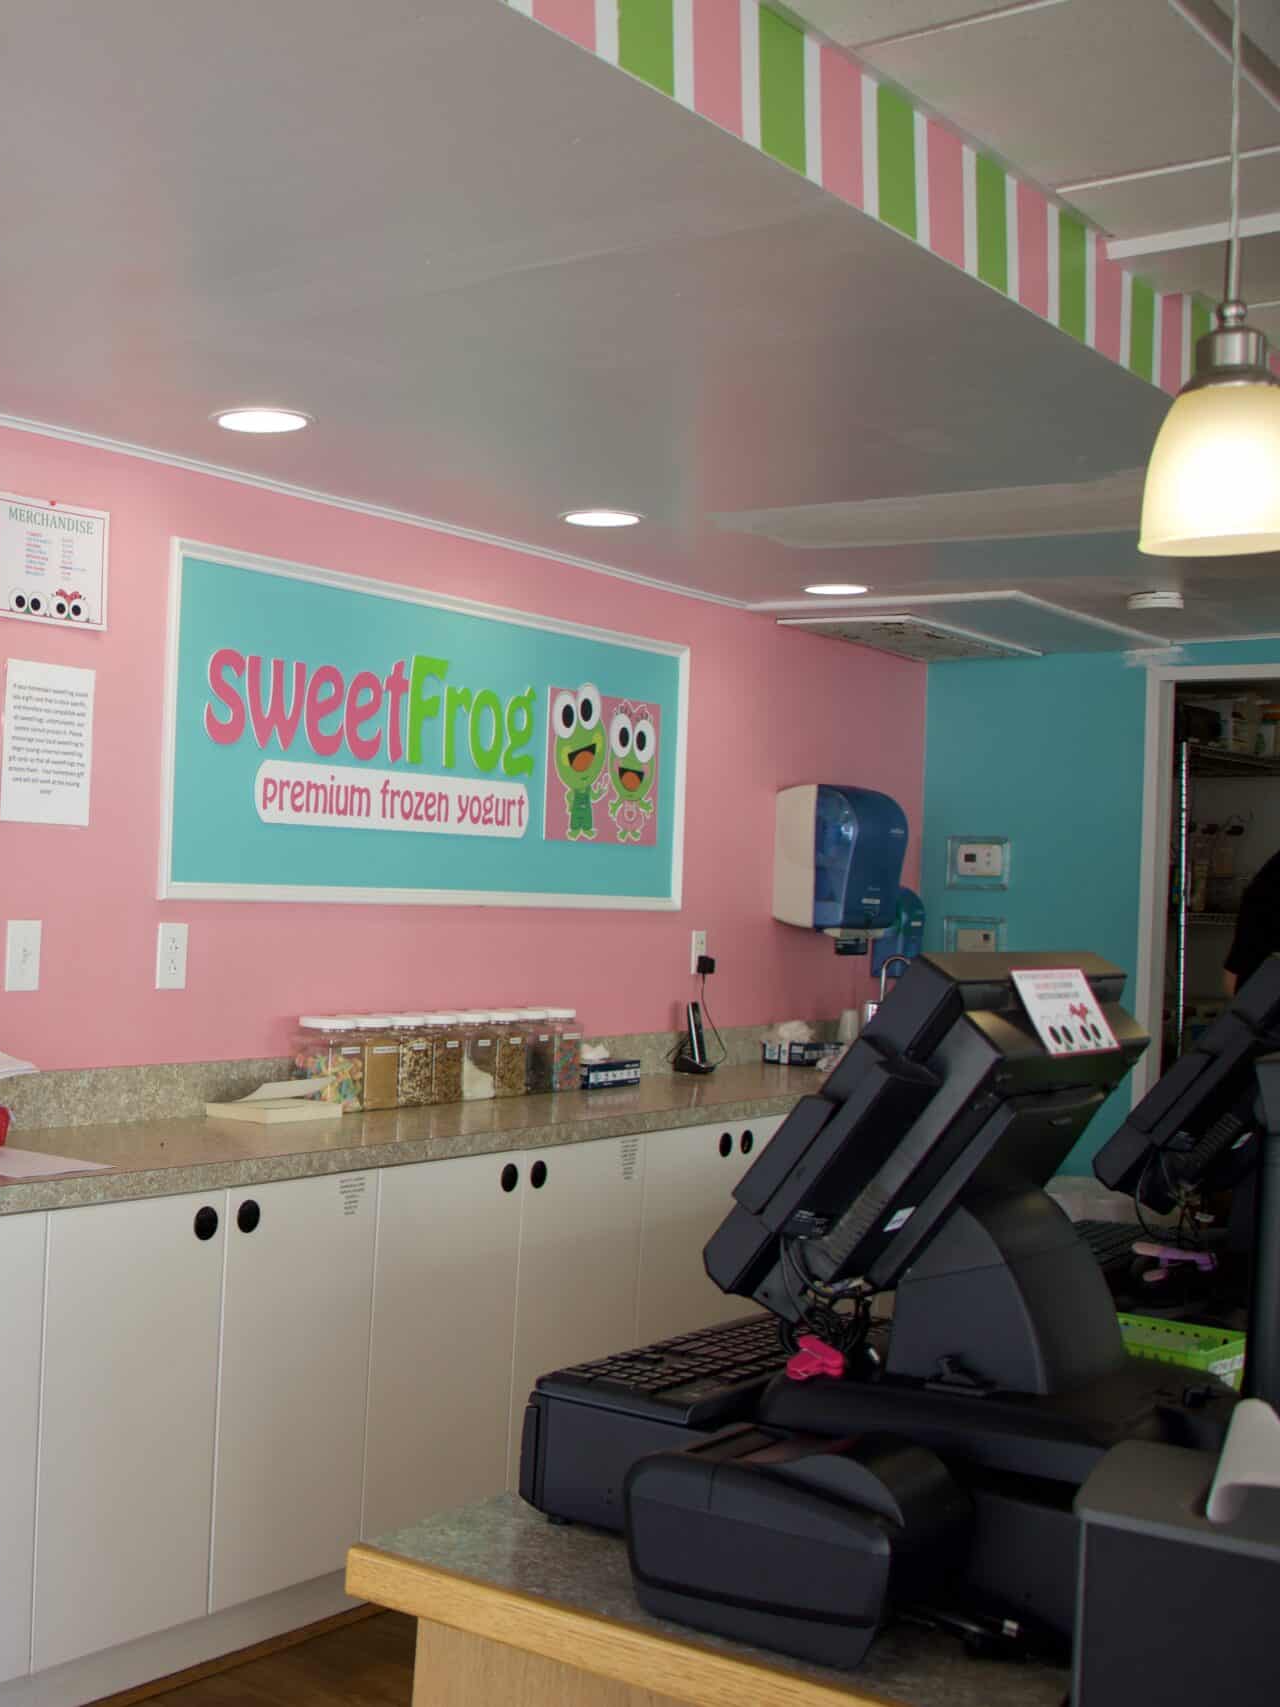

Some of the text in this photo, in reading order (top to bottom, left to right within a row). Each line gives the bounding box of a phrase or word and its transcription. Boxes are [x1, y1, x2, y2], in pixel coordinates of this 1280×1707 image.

[8, 506, 95, 535] MERCHANDISE
[204, 648, 536, 778] sweetFrog
[262, 775, 526, 829] premium frozen yogurt
